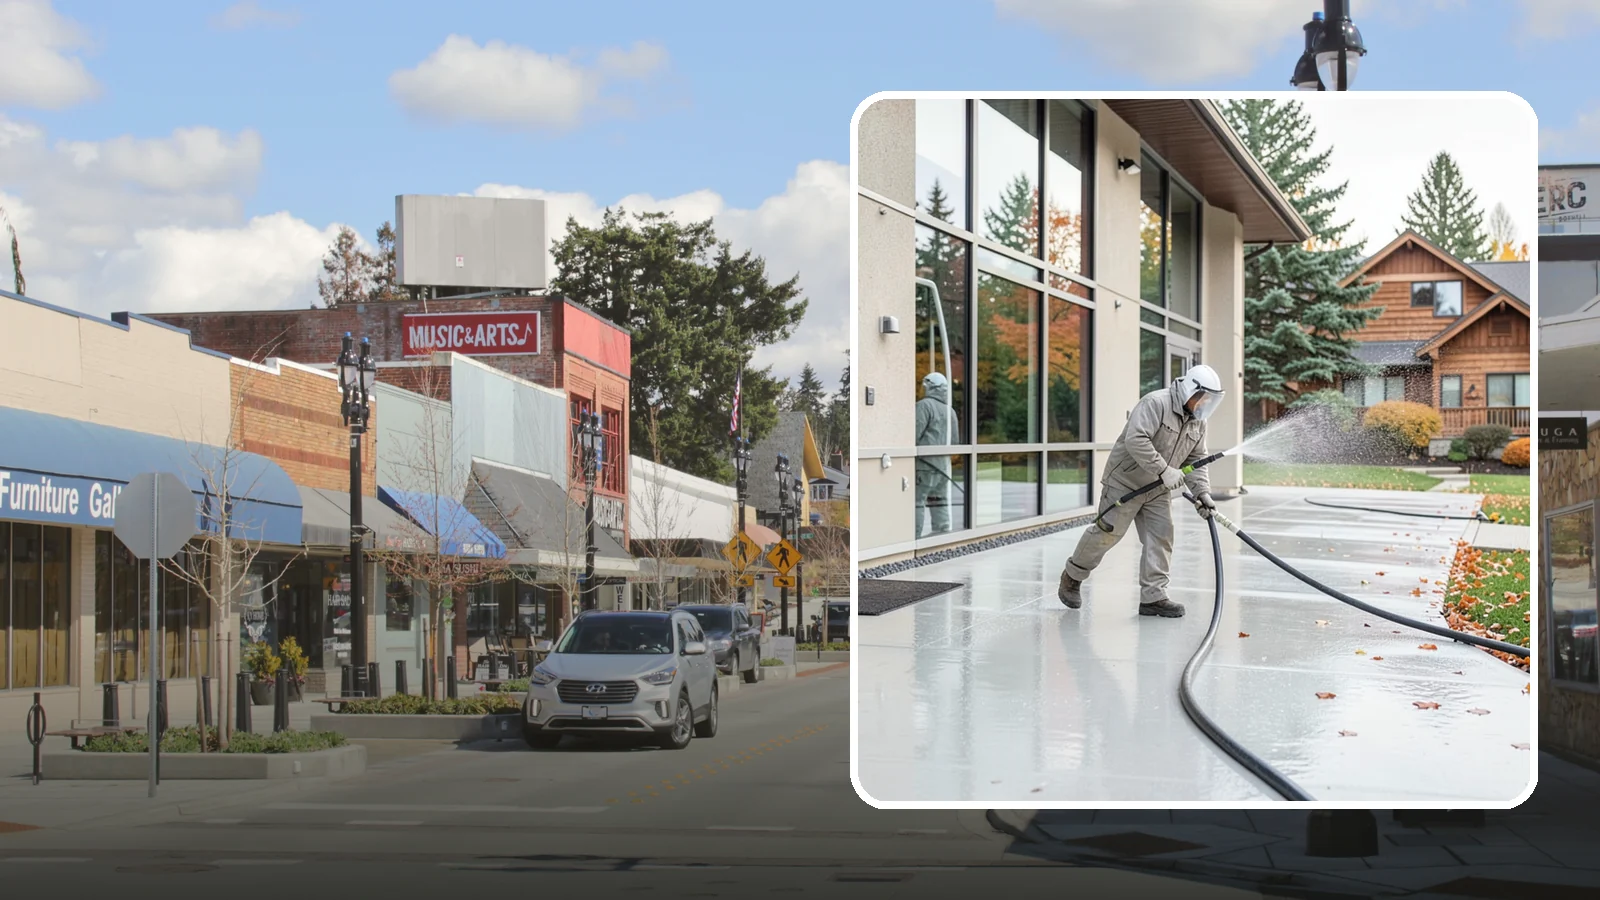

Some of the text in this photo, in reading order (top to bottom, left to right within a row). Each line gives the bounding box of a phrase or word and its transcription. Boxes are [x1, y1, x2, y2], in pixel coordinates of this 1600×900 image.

[409, 323, 520, 349] MUSIC&ARTS
[1540, 427, 1577, 437] UGA
[0, 471, 121, 519] Furniture Gal
